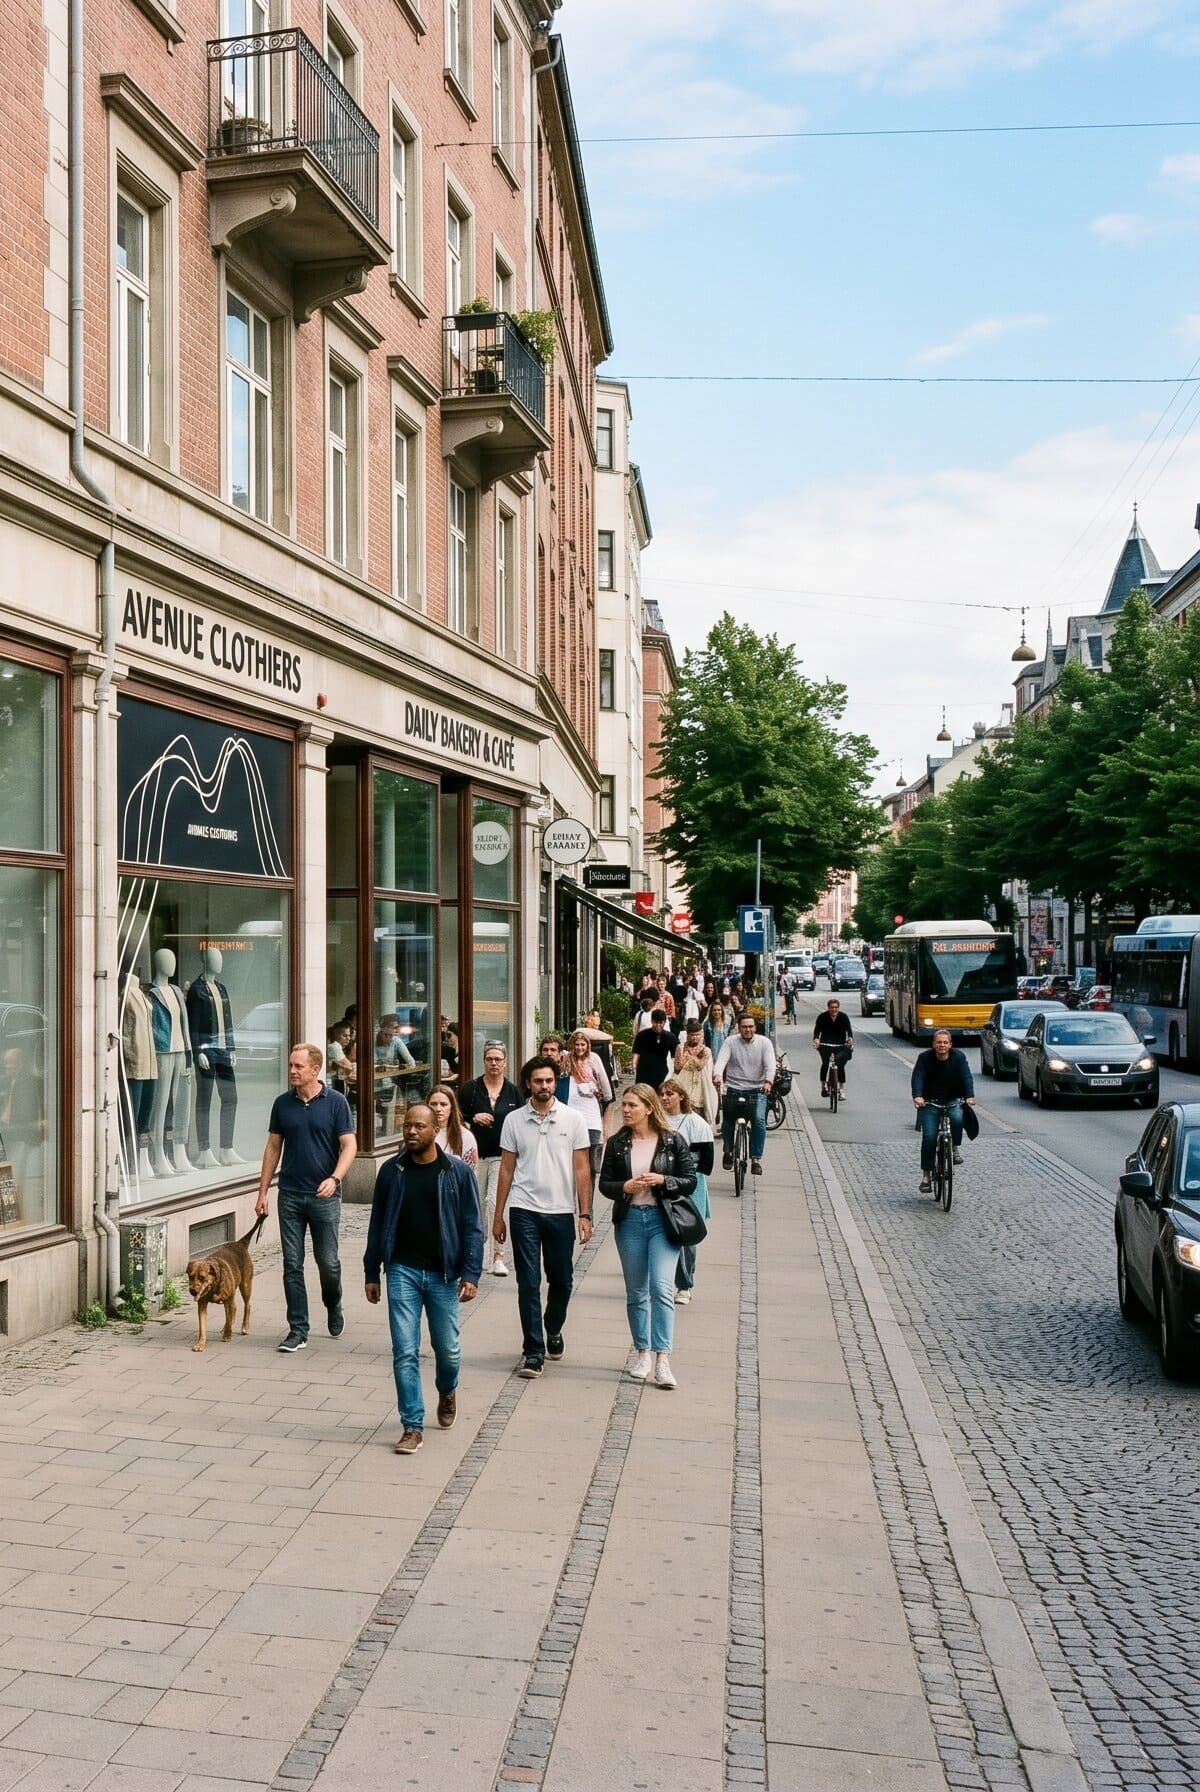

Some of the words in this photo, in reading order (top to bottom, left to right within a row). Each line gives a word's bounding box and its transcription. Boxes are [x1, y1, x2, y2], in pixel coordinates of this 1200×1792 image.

[122, 588, 204, 660] AVENUE
[210, 623, 301, 693] CLOTHIERS
[405, 700, 438, 743] DAILY
[441, 715, 481, 758] BAKERY
[483, 732, 490, 763] &
[492, 736, 515, 771] CAFÉ
